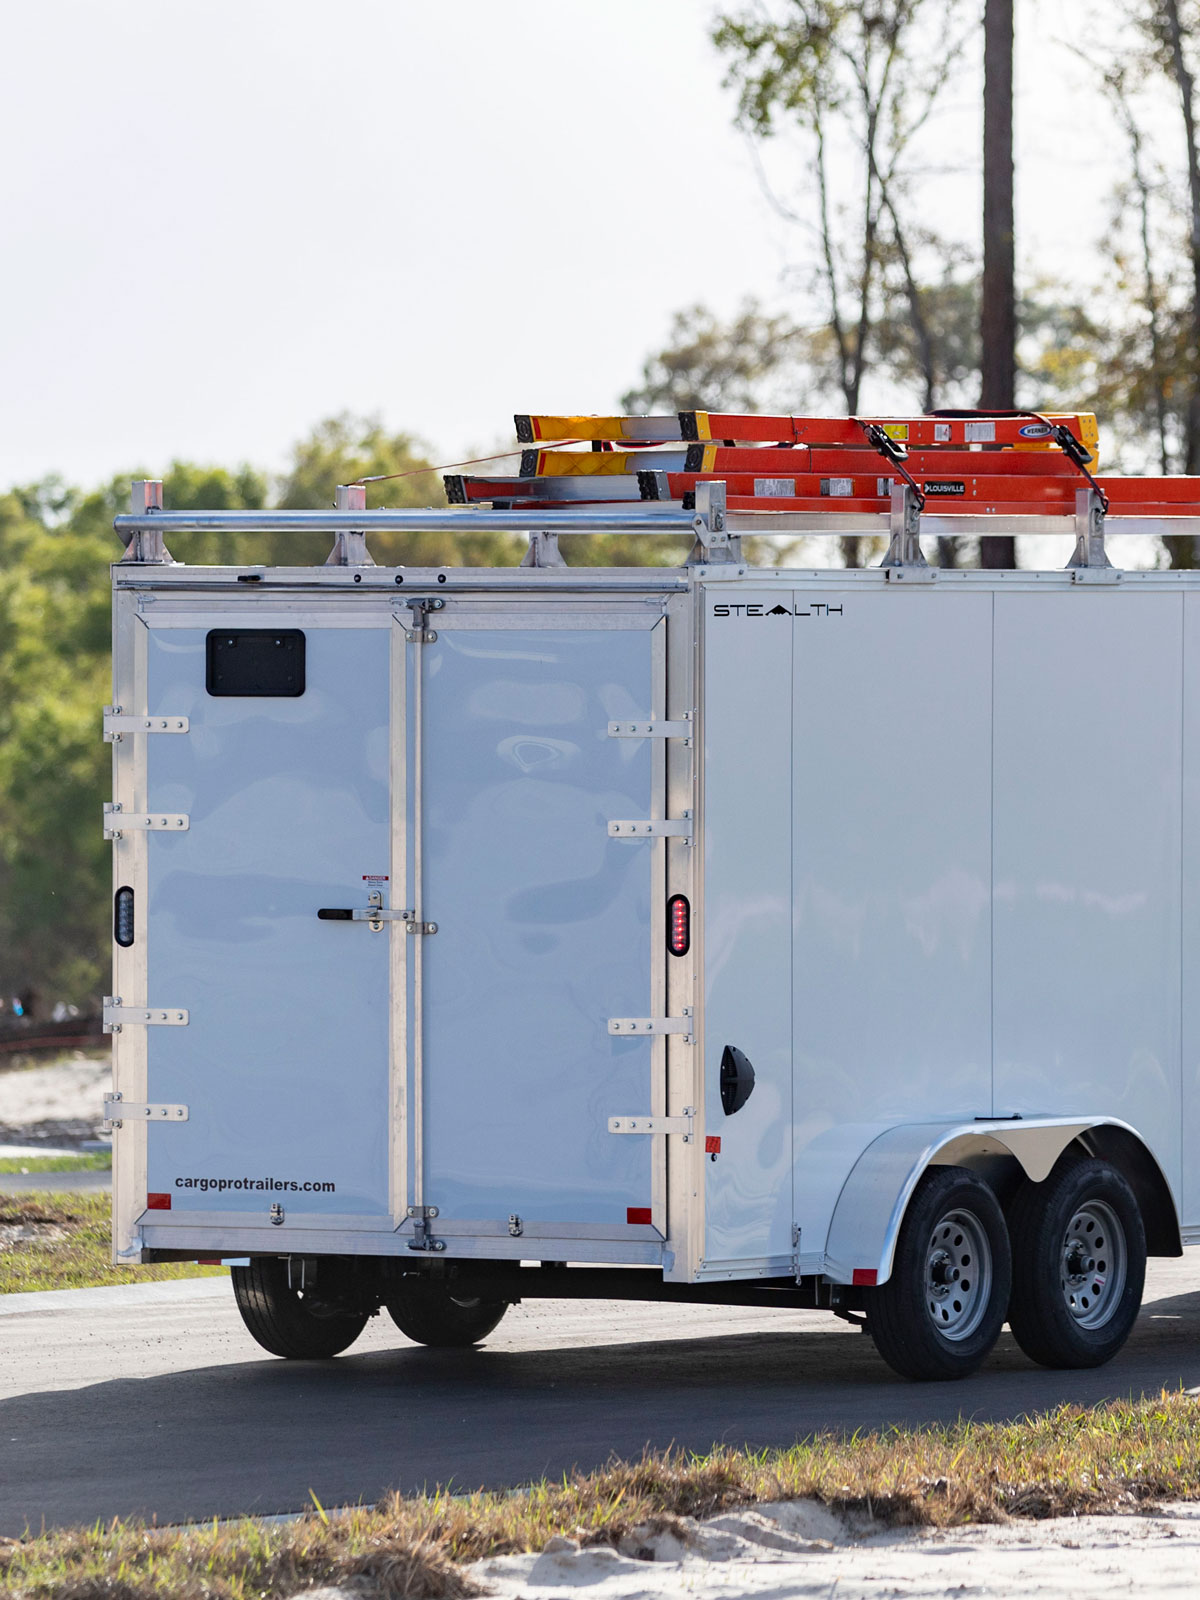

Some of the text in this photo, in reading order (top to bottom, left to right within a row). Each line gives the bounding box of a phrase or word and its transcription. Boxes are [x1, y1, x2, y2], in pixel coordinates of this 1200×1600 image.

[929, 485, 965, 493] LOUISVILLE
[713, 604, 843, 617] STEALTH
[175, 1177, 336, 1193] cargoprotrailers.com
